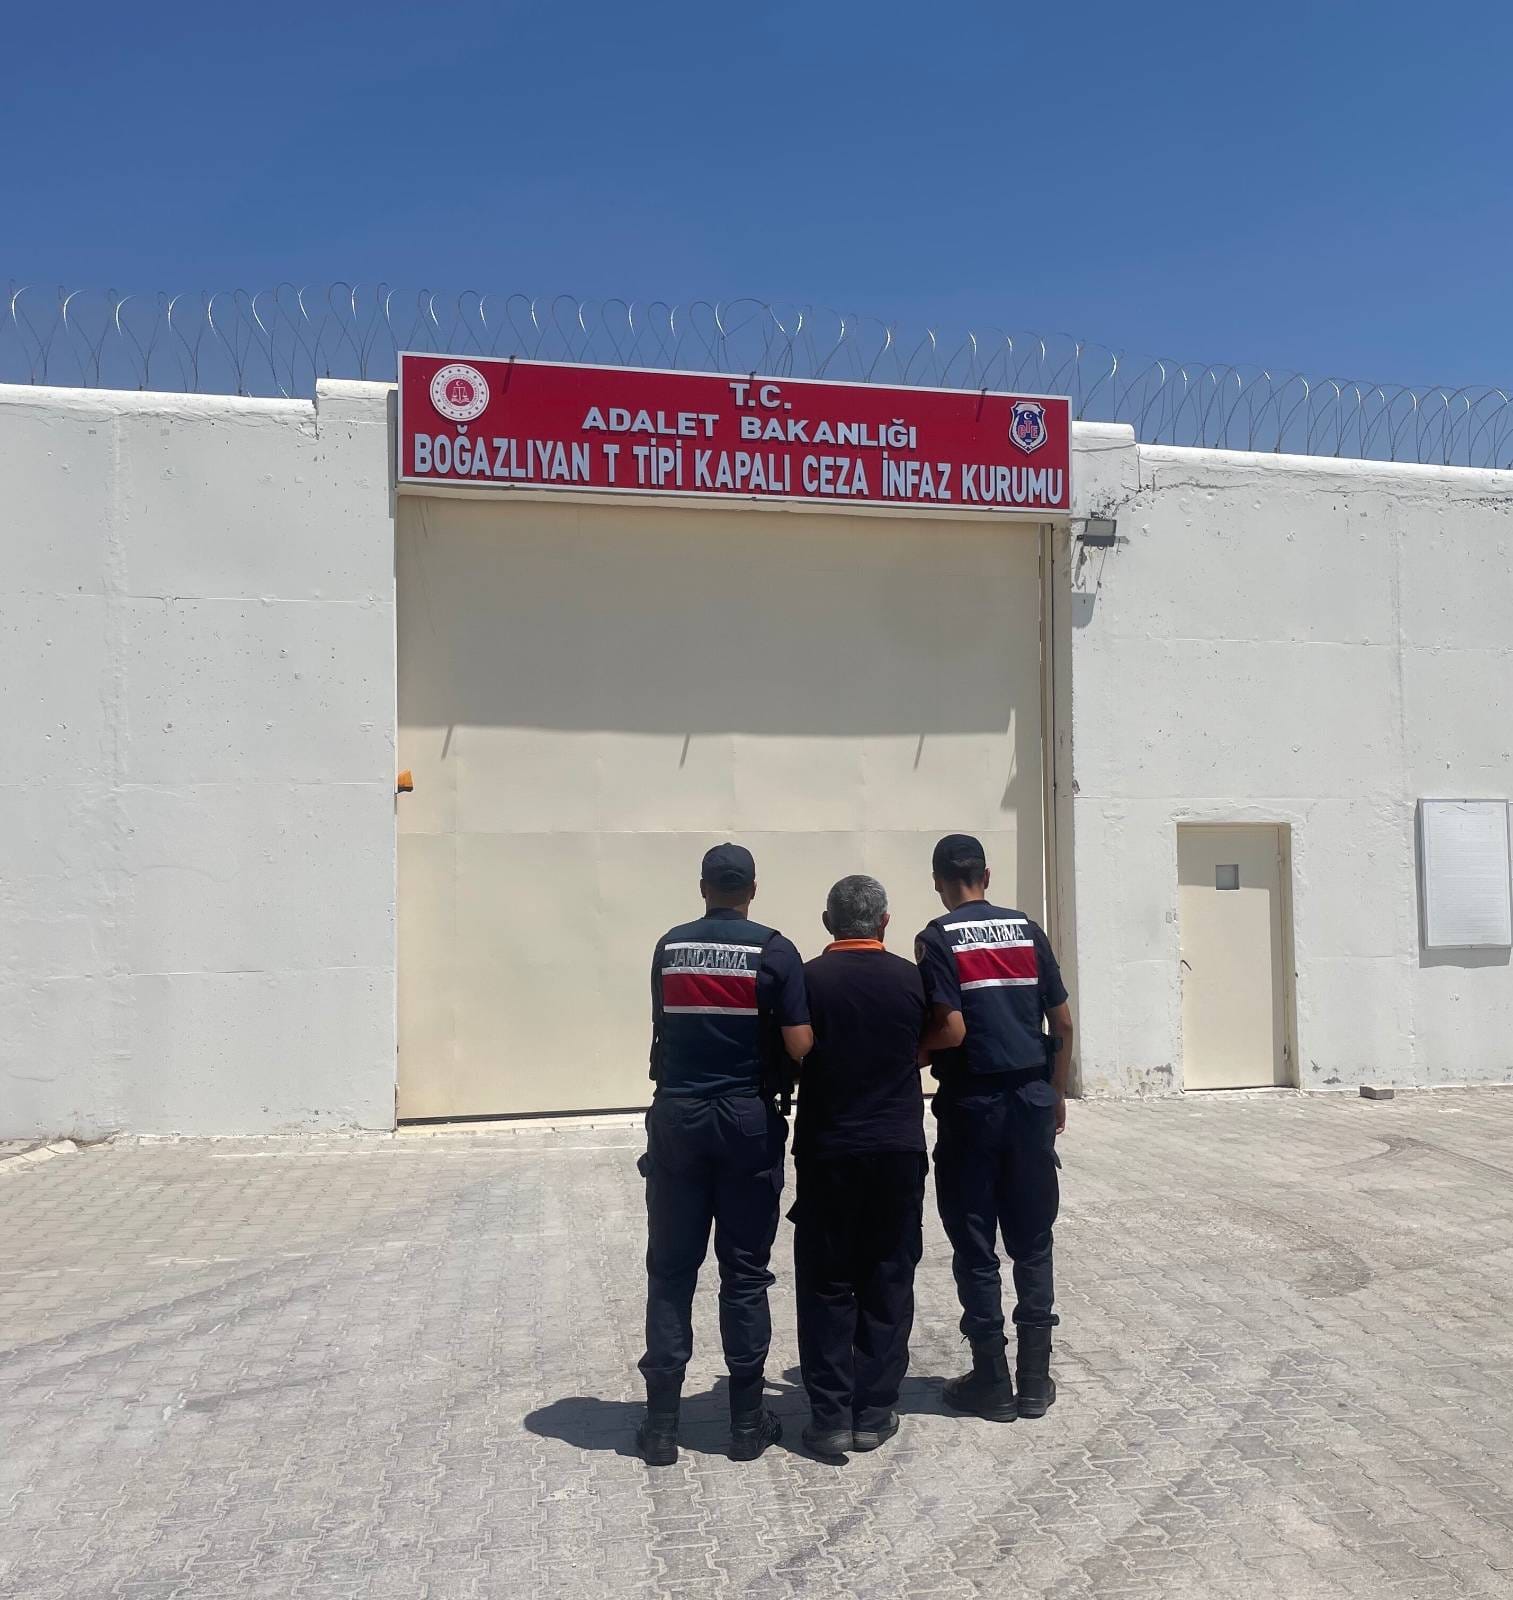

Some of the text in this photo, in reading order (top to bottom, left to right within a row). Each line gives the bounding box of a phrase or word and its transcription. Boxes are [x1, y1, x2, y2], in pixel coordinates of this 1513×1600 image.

[729, 382, 792, 409] T.C.
[582, 405, 916, 448] ADALET BAKANLIĞI
[414, 425, 1063, 505] BOĞAZLIYAN T TİPİ KAPALI CEZA İNFAZ KURUMU
[957, 924, 1025, 945] JANDARMA
[671, 948, 748, 969] JANDARMA
